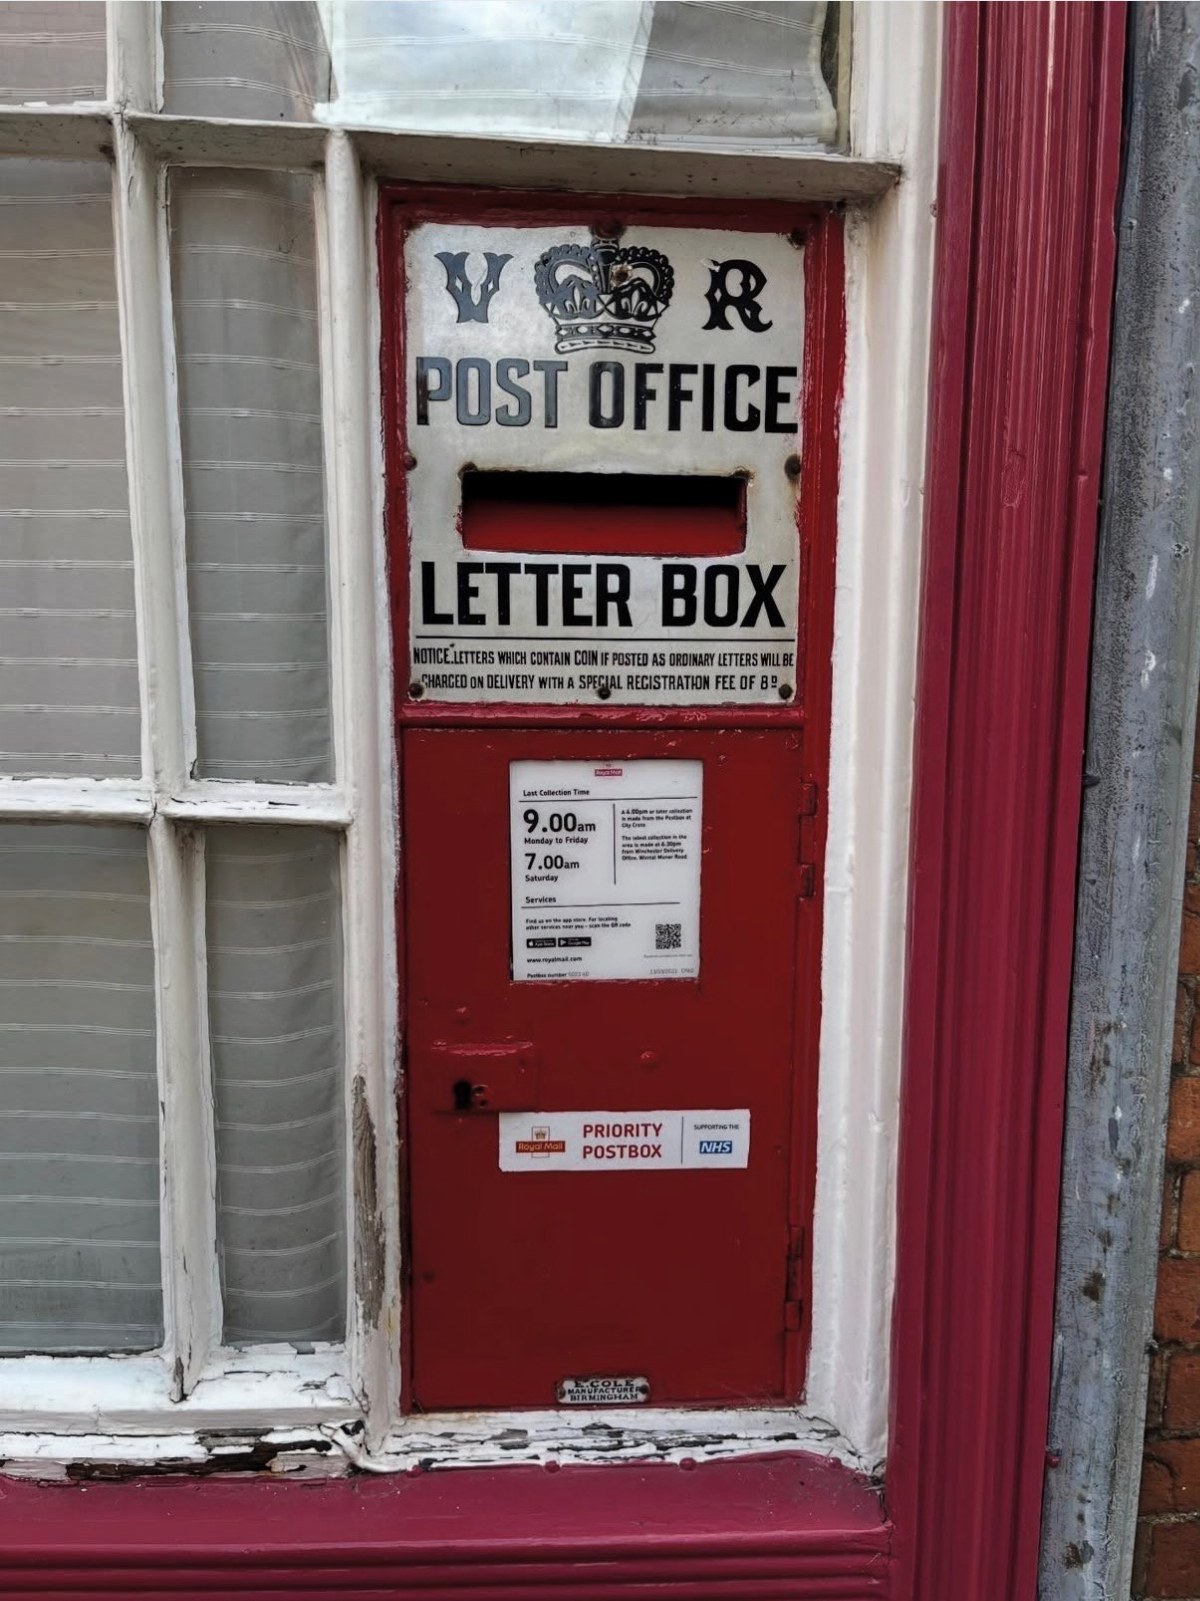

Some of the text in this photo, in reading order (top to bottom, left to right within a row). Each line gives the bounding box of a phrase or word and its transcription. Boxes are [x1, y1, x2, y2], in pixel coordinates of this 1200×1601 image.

[434, 251, 773, 332] V R
[416, 356, 798, 433] POST OFFICE
[420, 561, 787, 628] LETTER BOX
[498, 651, 526, 665] WHICH
[530, 651, 570, 666] CONTAIN
[574, 650, 598, 666] COIN
[601, 652, 609, 666] IF
[612, 652, 649, 666] POSTED
[652, 653, 665, 666] AS
[669, 653, 715, 666] ORDINARY
[718, 653, 758, 666] LETTERS
[760, 653, 781, 666] WILL
[782, 653, 794, 666] BE
[421, 673, 467, 688] CHARGED
[470, 676, 484, 688] ON
[487, 674, 534, 689] DELIVERY
[538, 676, 565, 689] WITH
[567, 676, 575, 689] A
[579, 675, 623, 689] SPECIAL
[627, 675, 710, 690] REGISTRATION
[715, 675, 736, 690] FEE
[740, 675, 756, 690] OF
[523, 809, 596, 833] 9.00am
[524, 837, 553, 845] Monday
[565, 836, 588, 844] Friday
[525, 853, 580, 870] 7.00am
[525, 874, 559, 883] Saturday
[525, 896, 557, 904] Services
[526, 956, 582, 964] www.royalmail.com
[582, 1123, 663, 1138] PRIORITY
[518, 1141, 563, 1152] Royal Mail
[582, 1144, 662, 1159] POSTBOX
[701, 1141, 731, 1153] NHS
[570, 1393, 638, 1402] BIRMINGHAM
